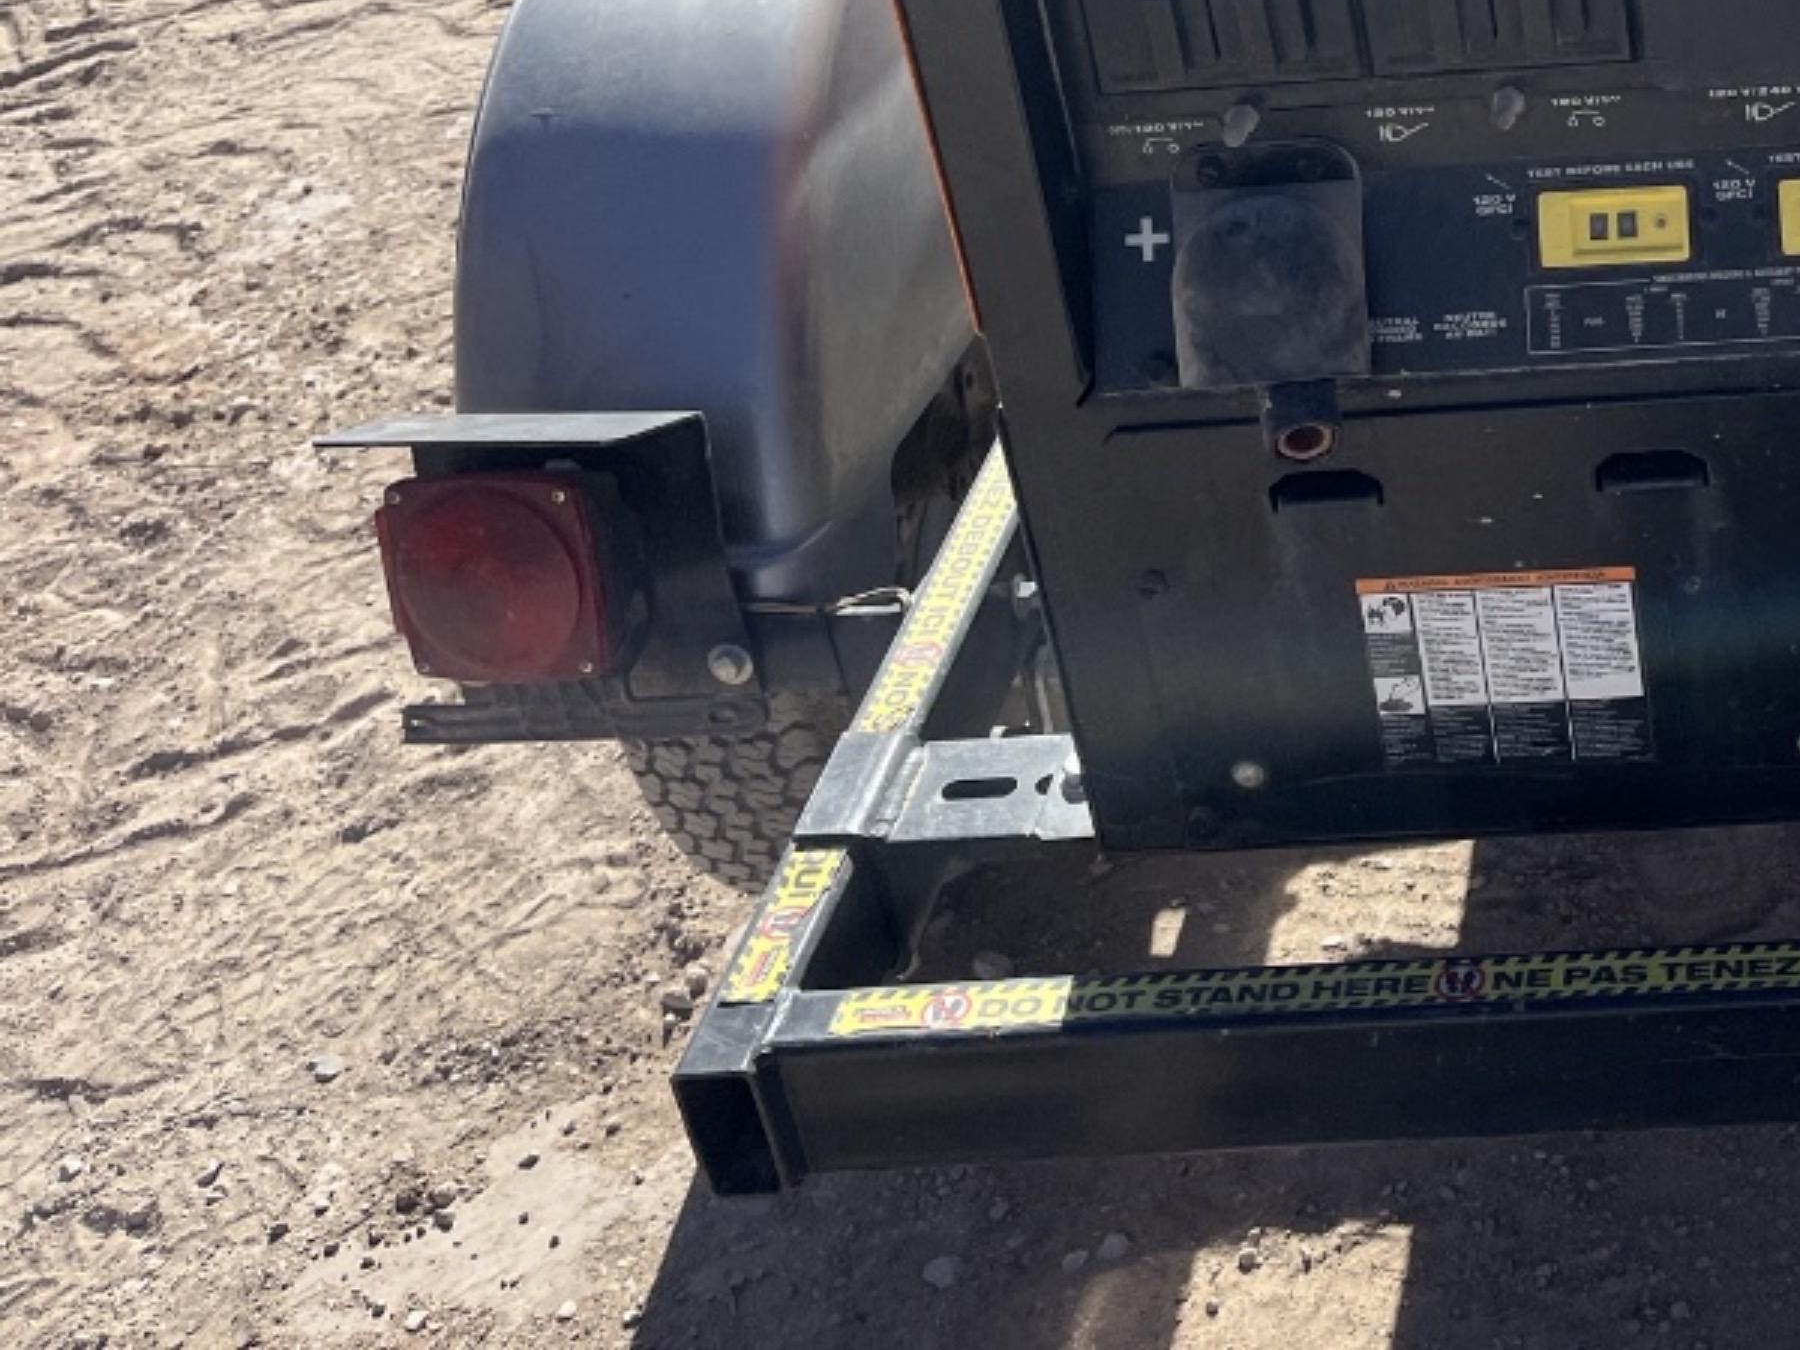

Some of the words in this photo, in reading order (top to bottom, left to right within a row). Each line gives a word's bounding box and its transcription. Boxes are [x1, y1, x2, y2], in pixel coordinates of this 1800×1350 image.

[1492, 966, 1554, 991] NE
[1563, 962, 1648, 987] PAS
[977, 995, 1042, 1018] DO
[1062, 985, 1147, 1016] NOT
[1155, 977, 1300, 1008] STAND
[1311, 974, 1428, 1000] HERE
